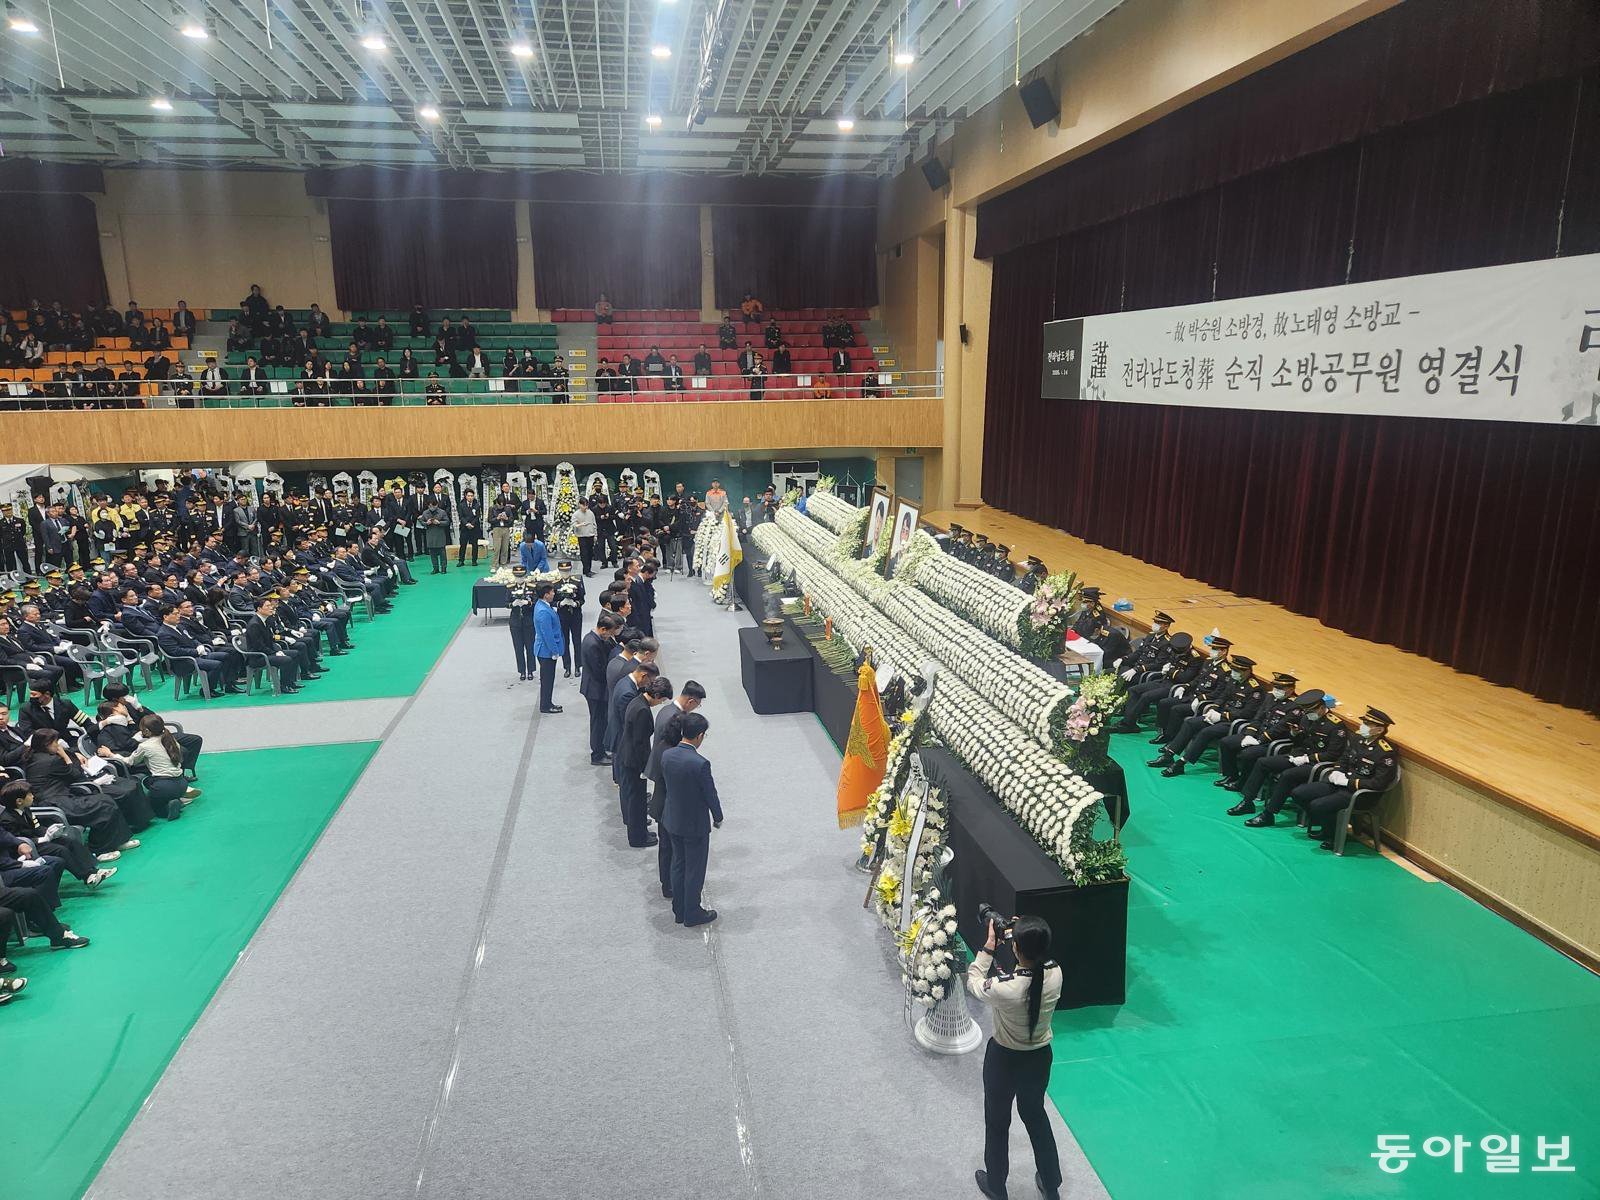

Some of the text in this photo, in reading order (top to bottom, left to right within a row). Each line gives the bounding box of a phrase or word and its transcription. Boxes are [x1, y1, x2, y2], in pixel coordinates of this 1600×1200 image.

[1188, 316, 1222, 342] 박승원
[1225, 312, 1267, 340] 소방경,
[1290, 304, 1339, 335] 노태영
[1343, 300, 1401, 332] 소방교
[1225, 353, 1264, 392] 순직
[1271, 348, 1403, 393] 소방공무원
[1419, 344, 1523, 396] 영결식
